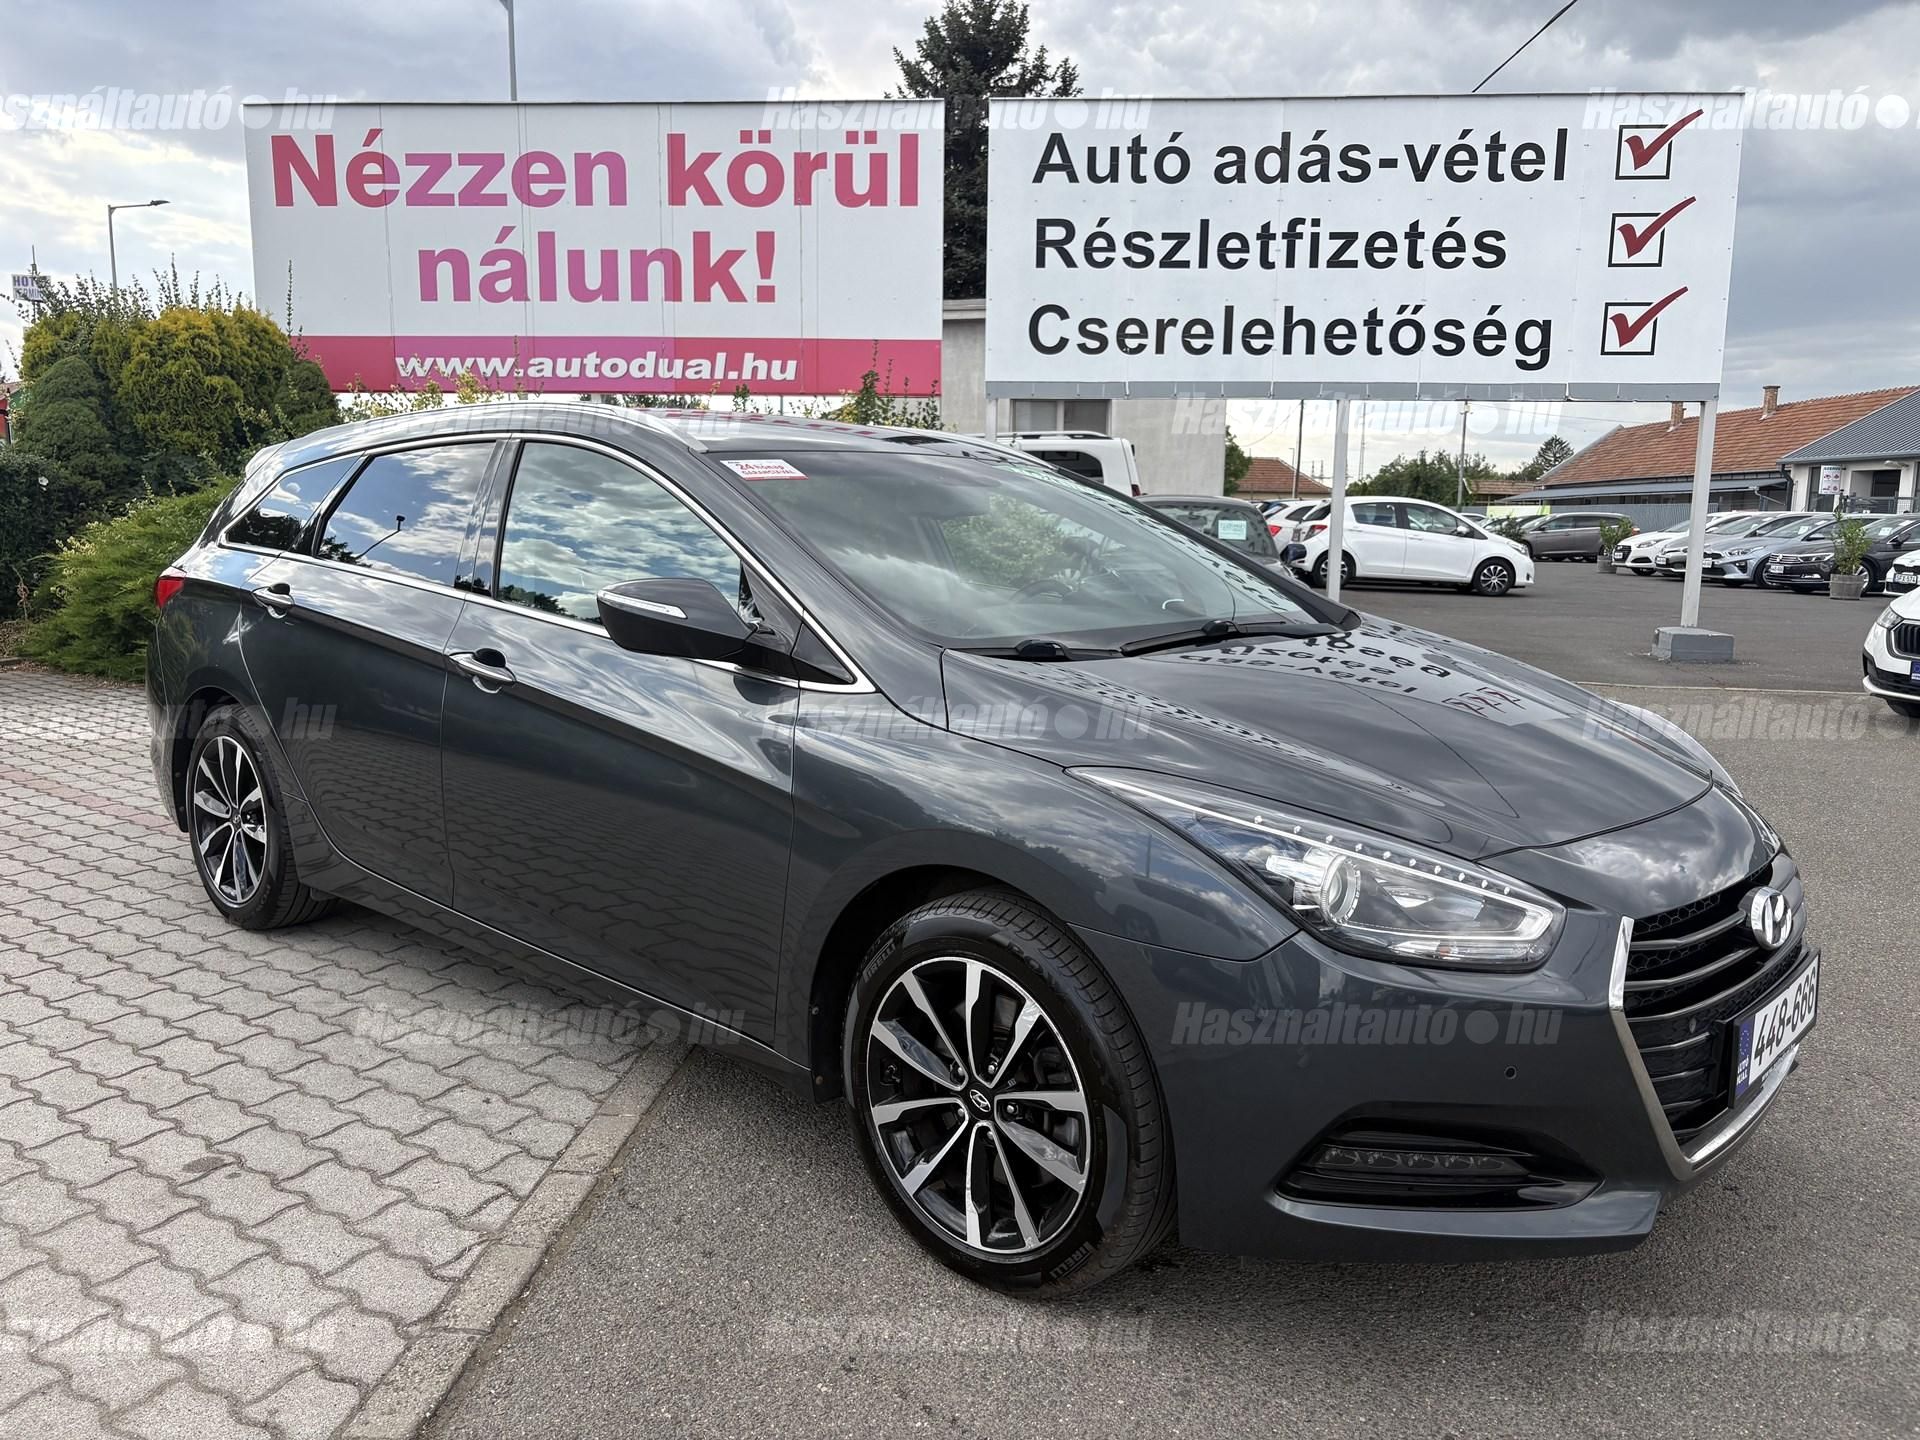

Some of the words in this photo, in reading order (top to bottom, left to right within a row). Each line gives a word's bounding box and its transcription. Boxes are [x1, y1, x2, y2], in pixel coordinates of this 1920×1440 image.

[271, 129, 626, 207] Nézzen
[668, 132, 918, 208] körül
[1032, 132, 1191, 185] Autó
[1213, 128, 1568, 184] adás-vétel
[420, 226, 775, 302] nálunk!
[1035, 217, 1507, 270] Részletfizetés
[395, 351, 797, 381] www.autodual.hu
[1028, 305, 1552, 371] Cserelehetőség
[1754, 966, 1816, 1066] 448-666
